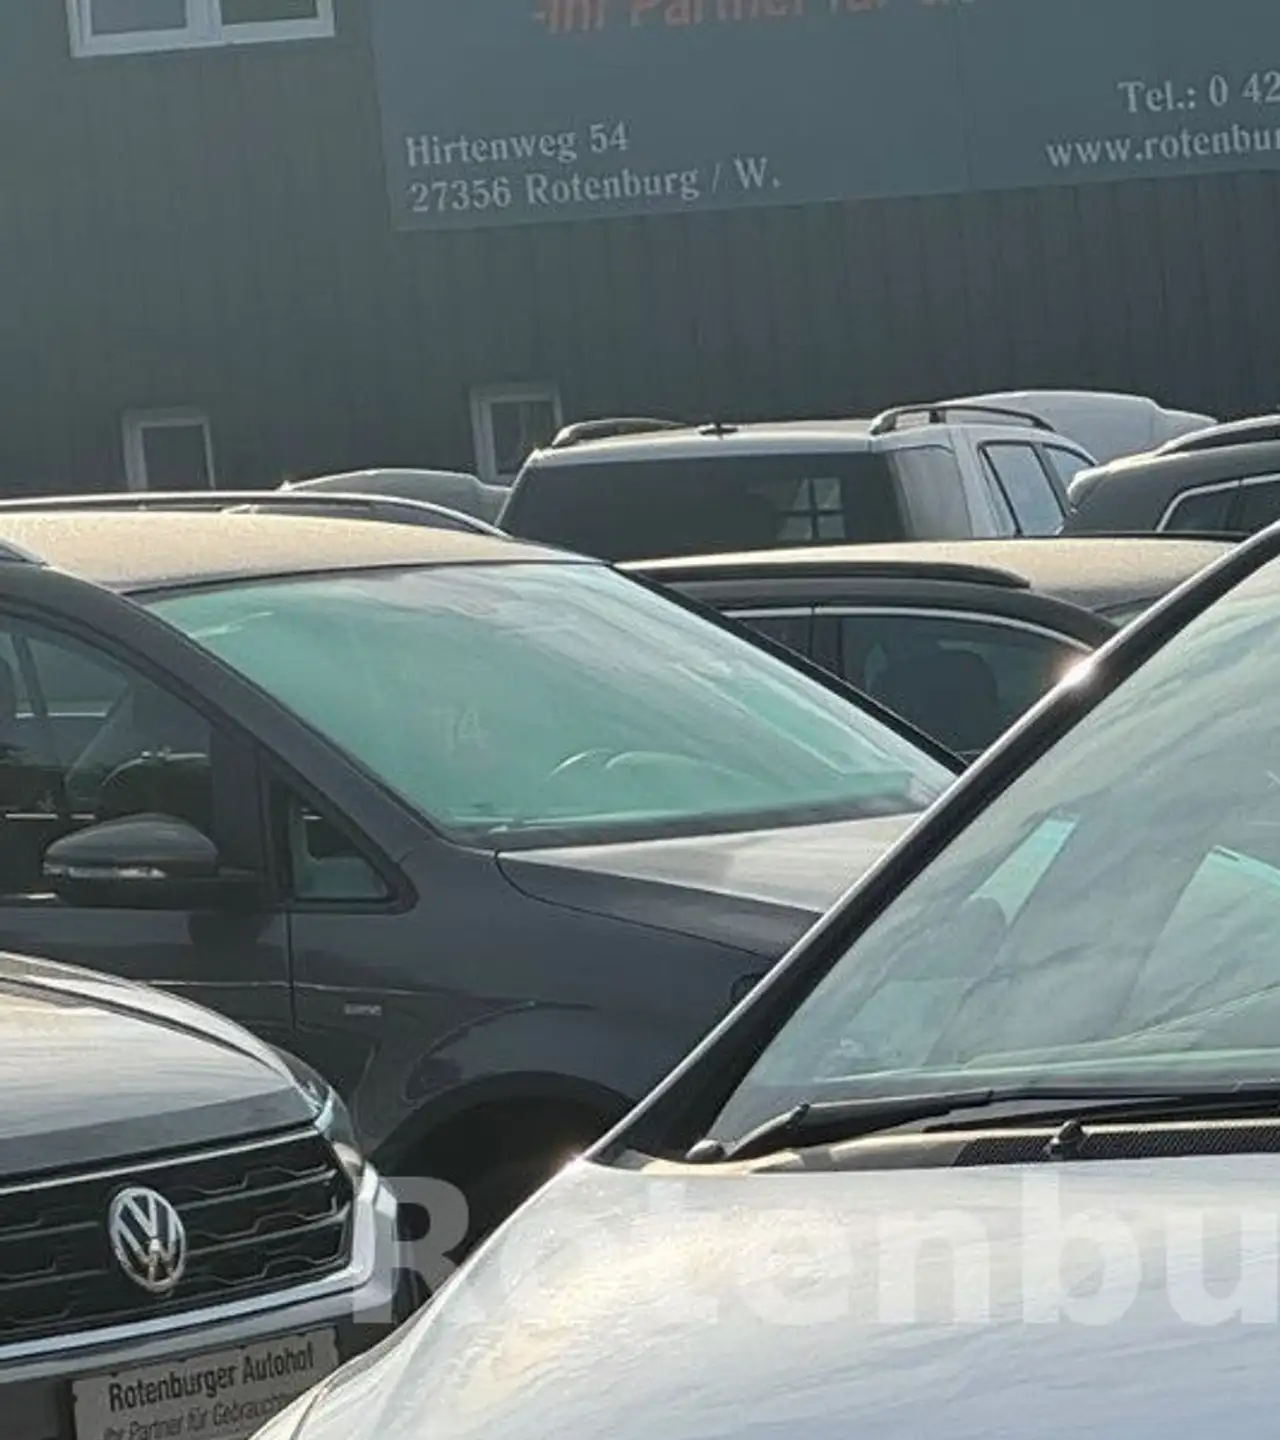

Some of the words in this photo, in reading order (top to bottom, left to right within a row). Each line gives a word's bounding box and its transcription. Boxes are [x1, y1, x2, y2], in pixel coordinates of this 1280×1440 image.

[1117, 78, 1198, 113] Tel.:
[1208, 75, 1229, 107] 0
[404, 129, 578, 168] Hirtenweg
[589, 120, 631, 156] 54
[409, 178, 514, 213] 27356
[524, 167, 700, 208] Rotenburg
[732, 154, 783, 191] W.
[108, 1363, 237, 1413] Rotenburger
[241, 1341, 315, 1386] Autohof
